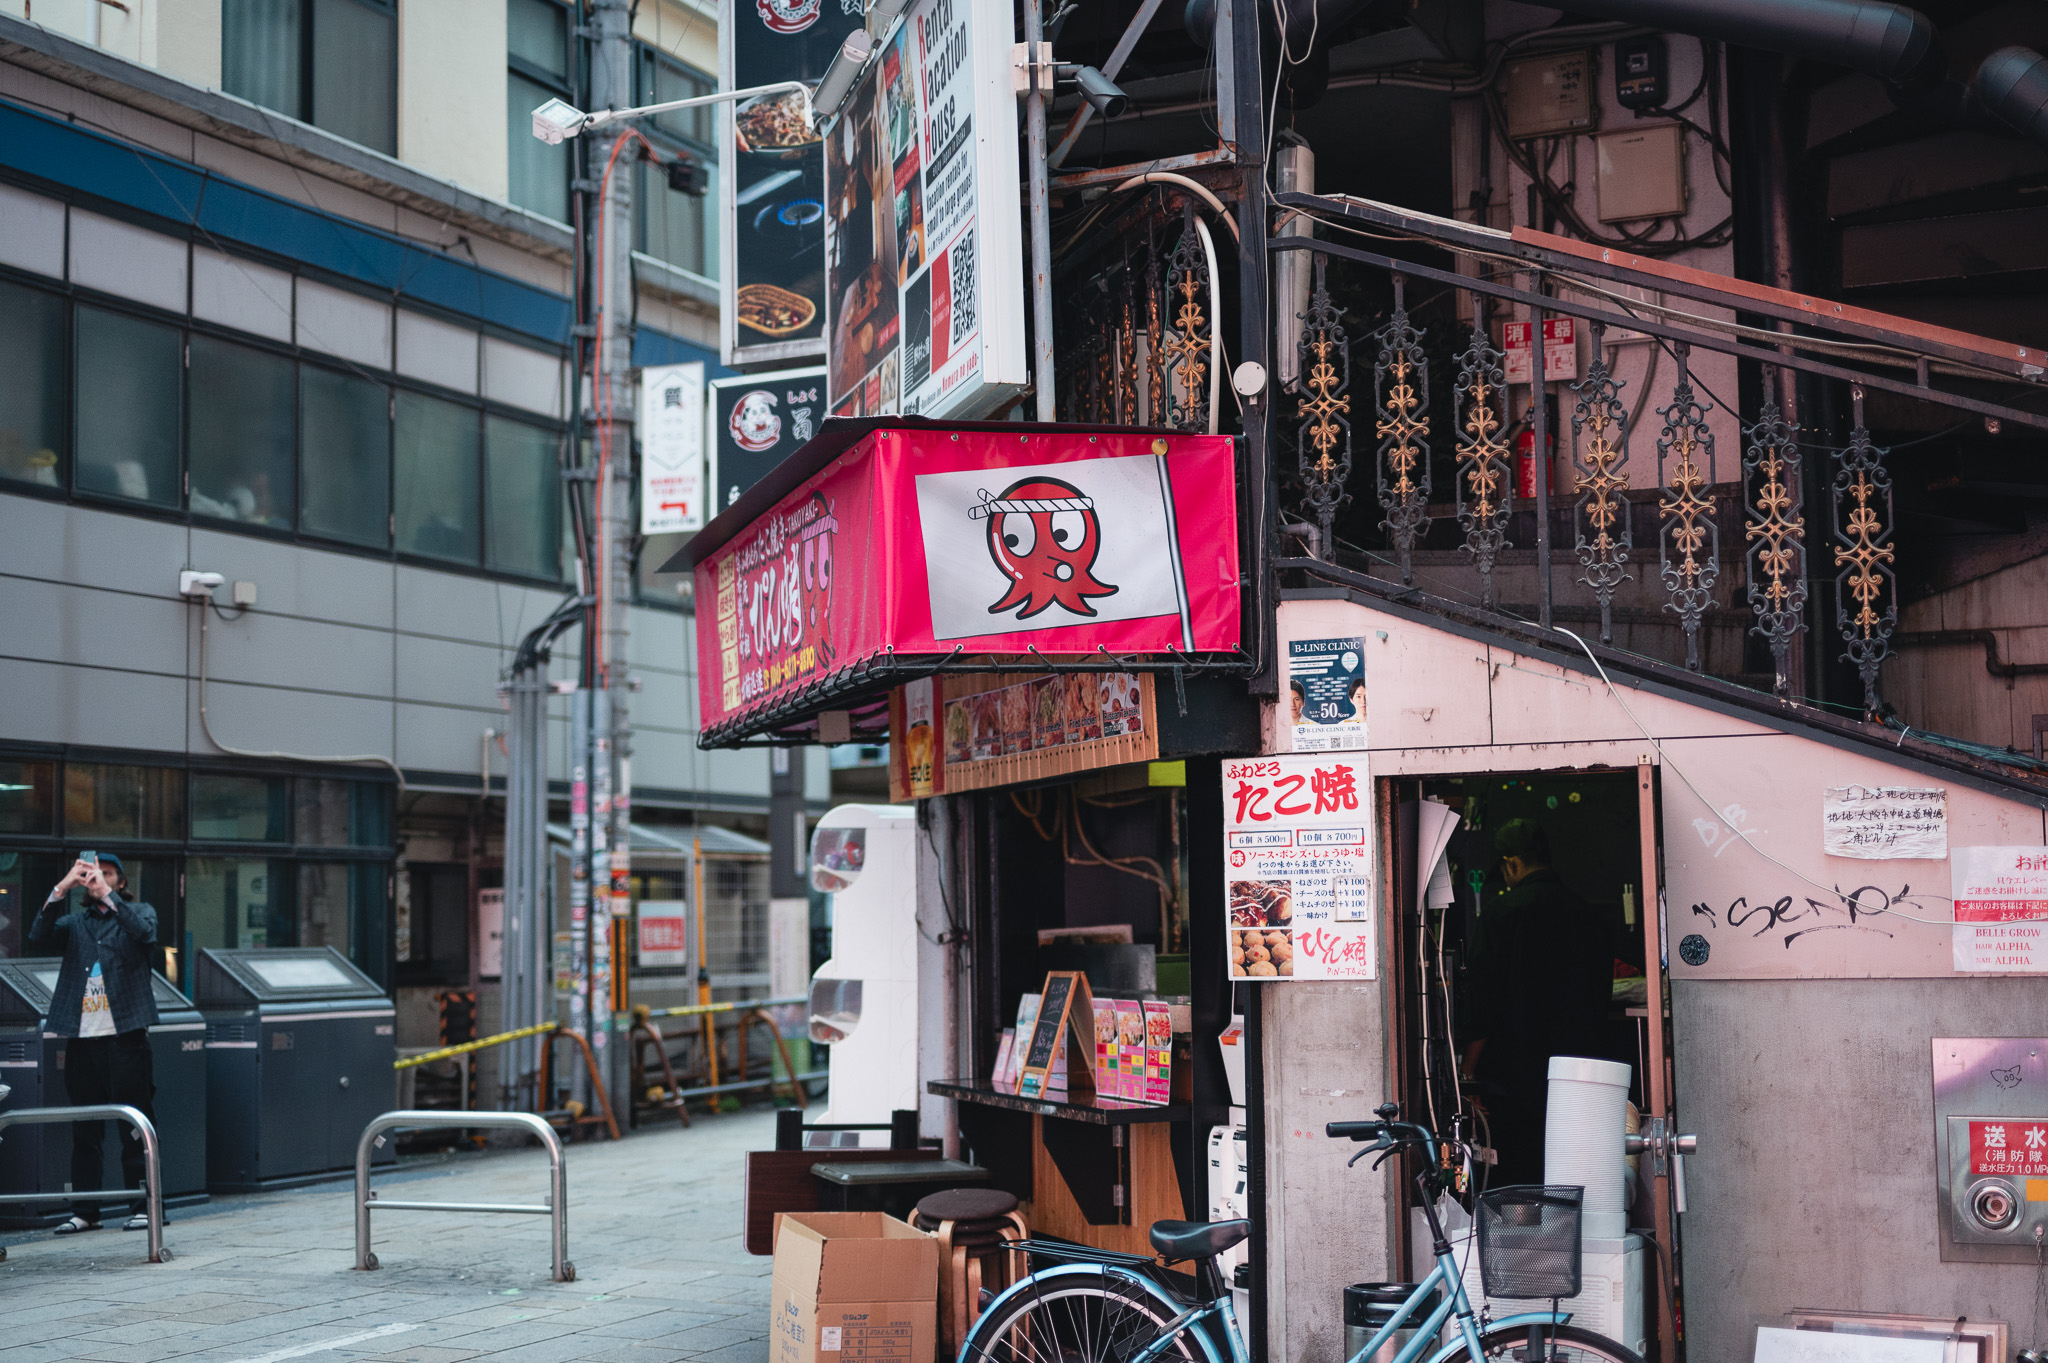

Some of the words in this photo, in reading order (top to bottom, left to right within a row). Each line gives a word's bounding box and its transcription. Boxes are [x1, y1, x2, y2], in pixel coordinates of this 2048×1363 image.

[920, 20, 967, 113] Vacation
[924, 94, 956, 165] House
[1295, 643, 1326, 653] B-LINE
[1328, 641, 1360, 651] CLINIC
[1321, 702, 1338, 718] 50
[1227, 761, 1281, 779] ふわとろ
[1232, 764, 1359, 824] たこ焼
[1232, 852, 1244, 866] 味
[1960, 901, 2047, 910] ご来店のお客様は下記に
[1976, 928, 2006, 937] BELLE
[2009, 928, 2040, 937] GROW
[1995, 942, 2033, 951] ALPHA.
[1995, 956, 2032, 965] ALPHA.
[1979, 1163, 2015, 1173] 送水圧力
[2018, 1164, 2032, 1174] 1.0
